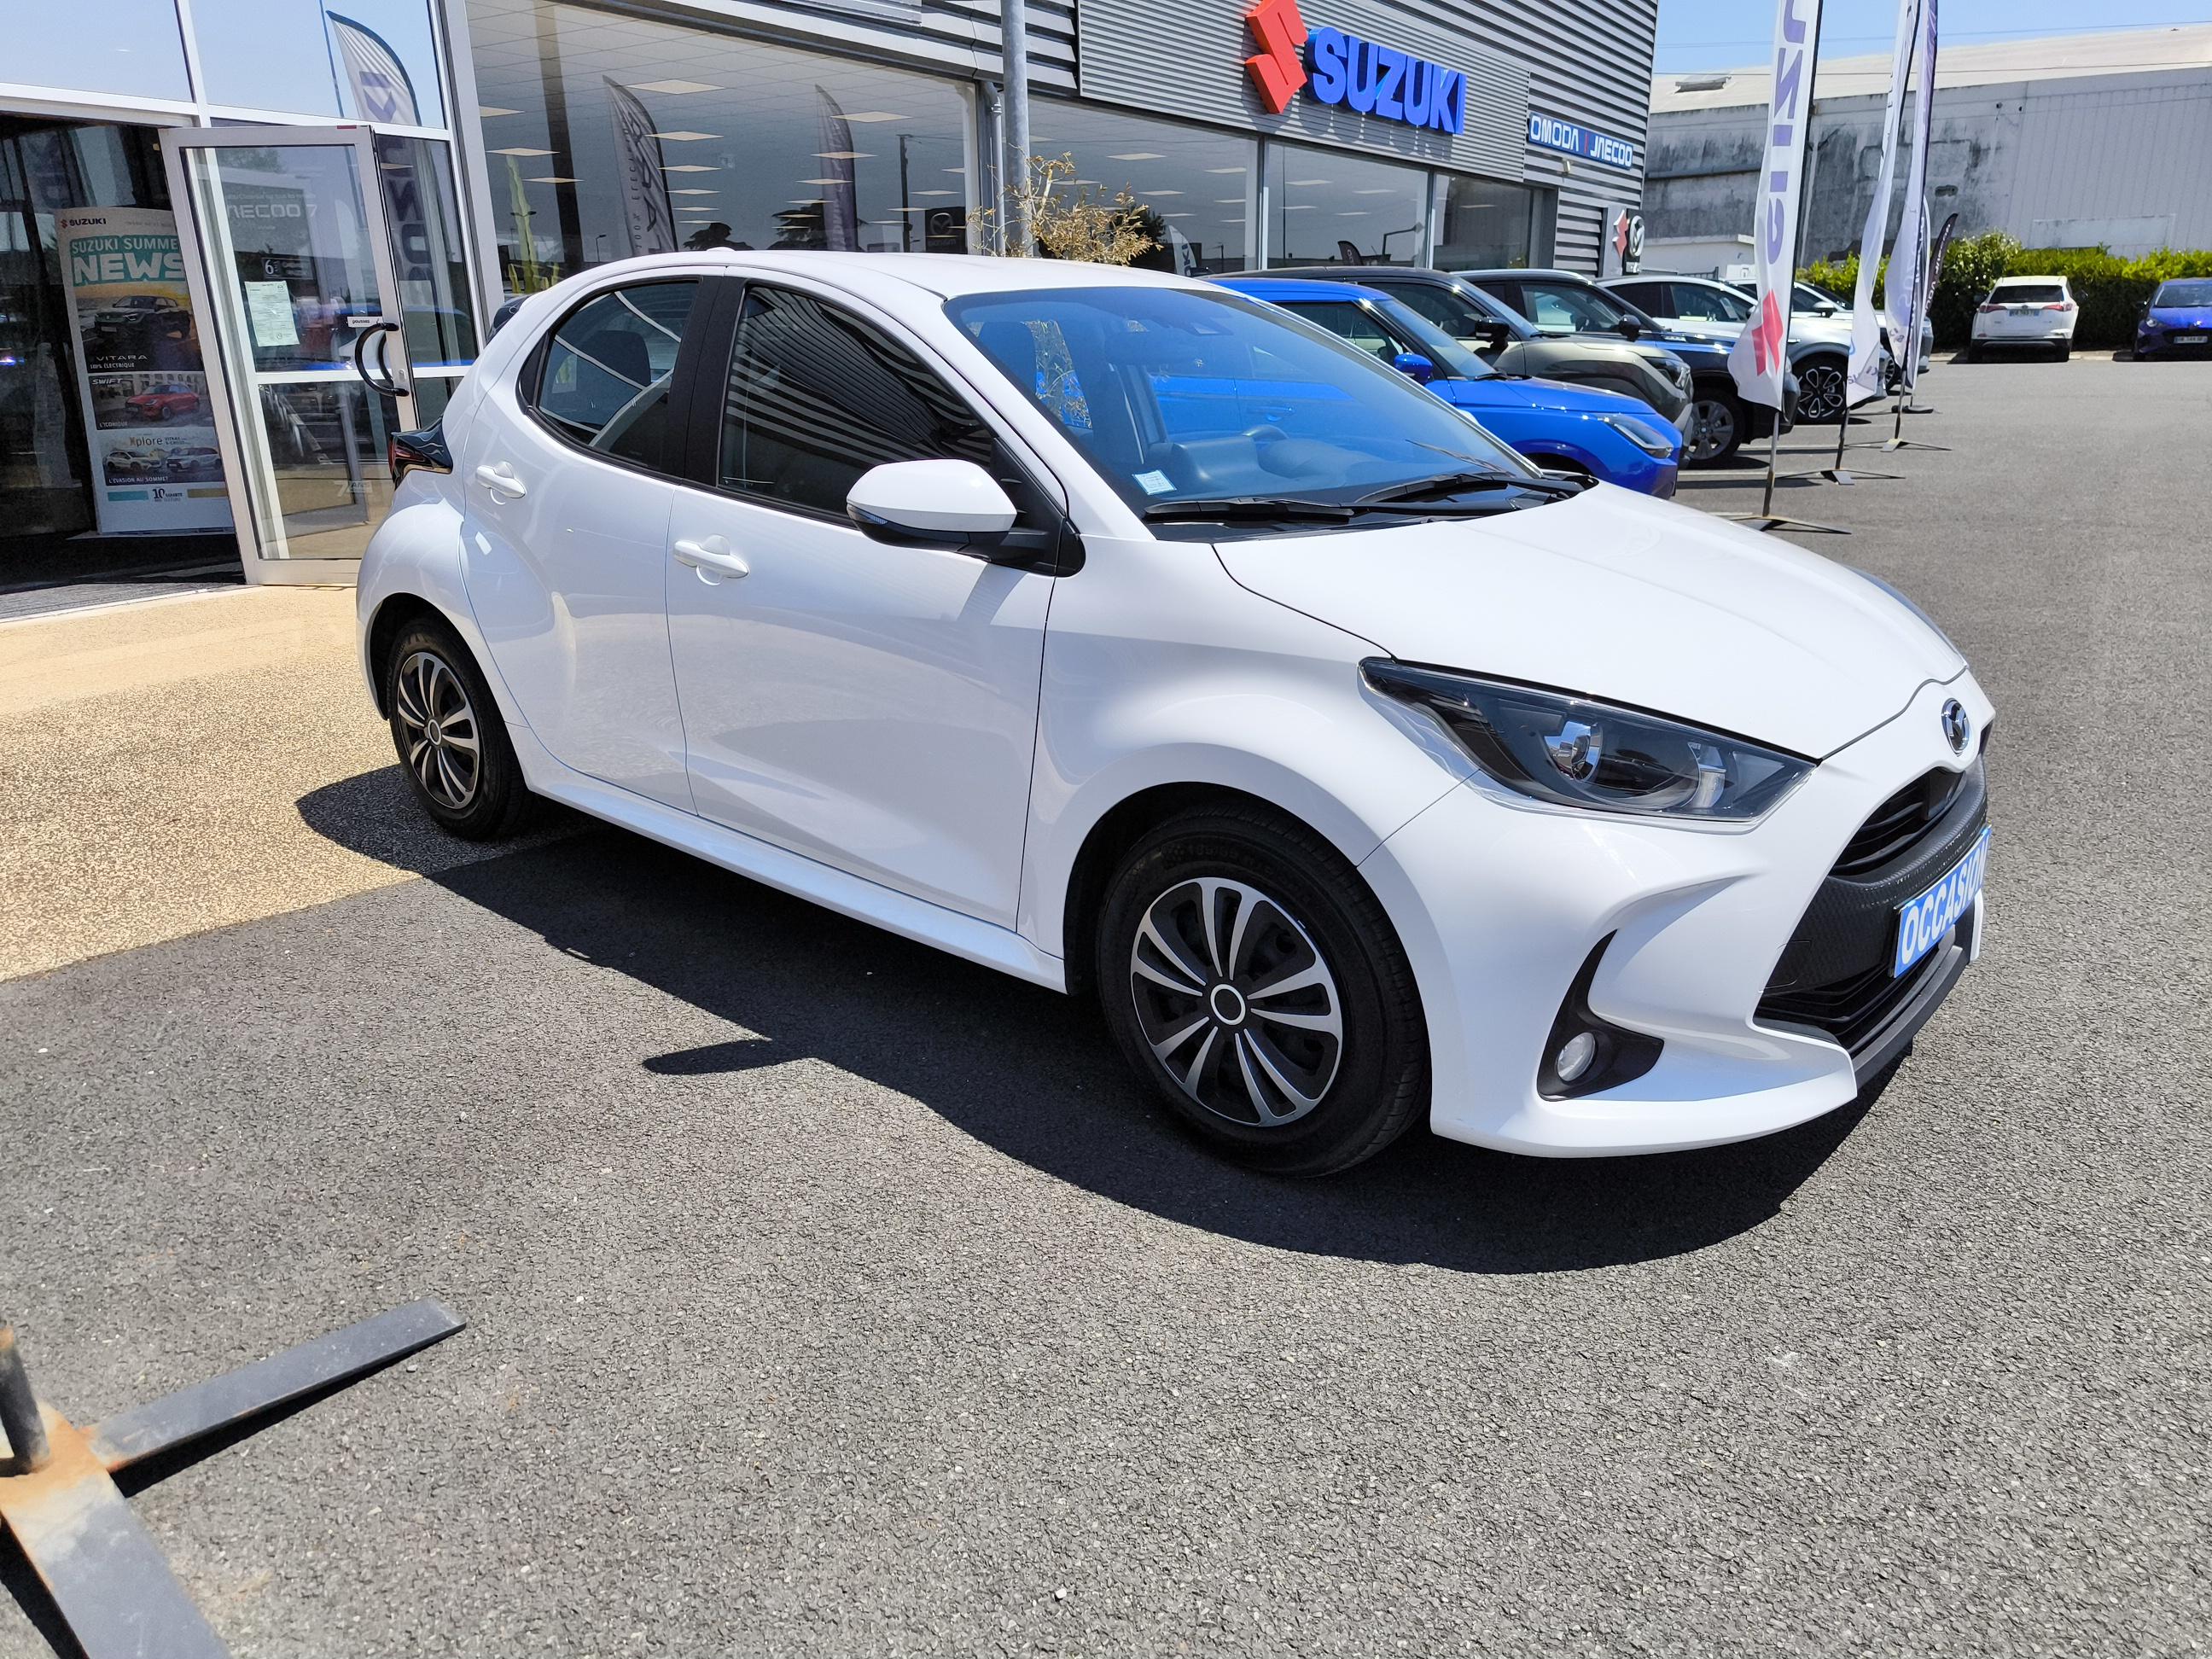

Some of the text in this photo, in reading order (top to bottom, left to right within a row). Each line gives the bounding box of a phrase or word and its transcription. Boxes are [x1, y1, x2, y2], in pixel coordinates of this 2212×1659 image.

[1311, 26, 1467, 136] SUZUKI
[1530, 115, 1633, 167] OMODA JAECOO
[69, 218, 107, 226] SUZUKI
[72, 237, 180, 254] SUZUKI SUMME
[73, 253, 186, 284] NEWS
[129, 436, 163, 447] Xplore
[1901, 834, 1989, 965] OCCASION
